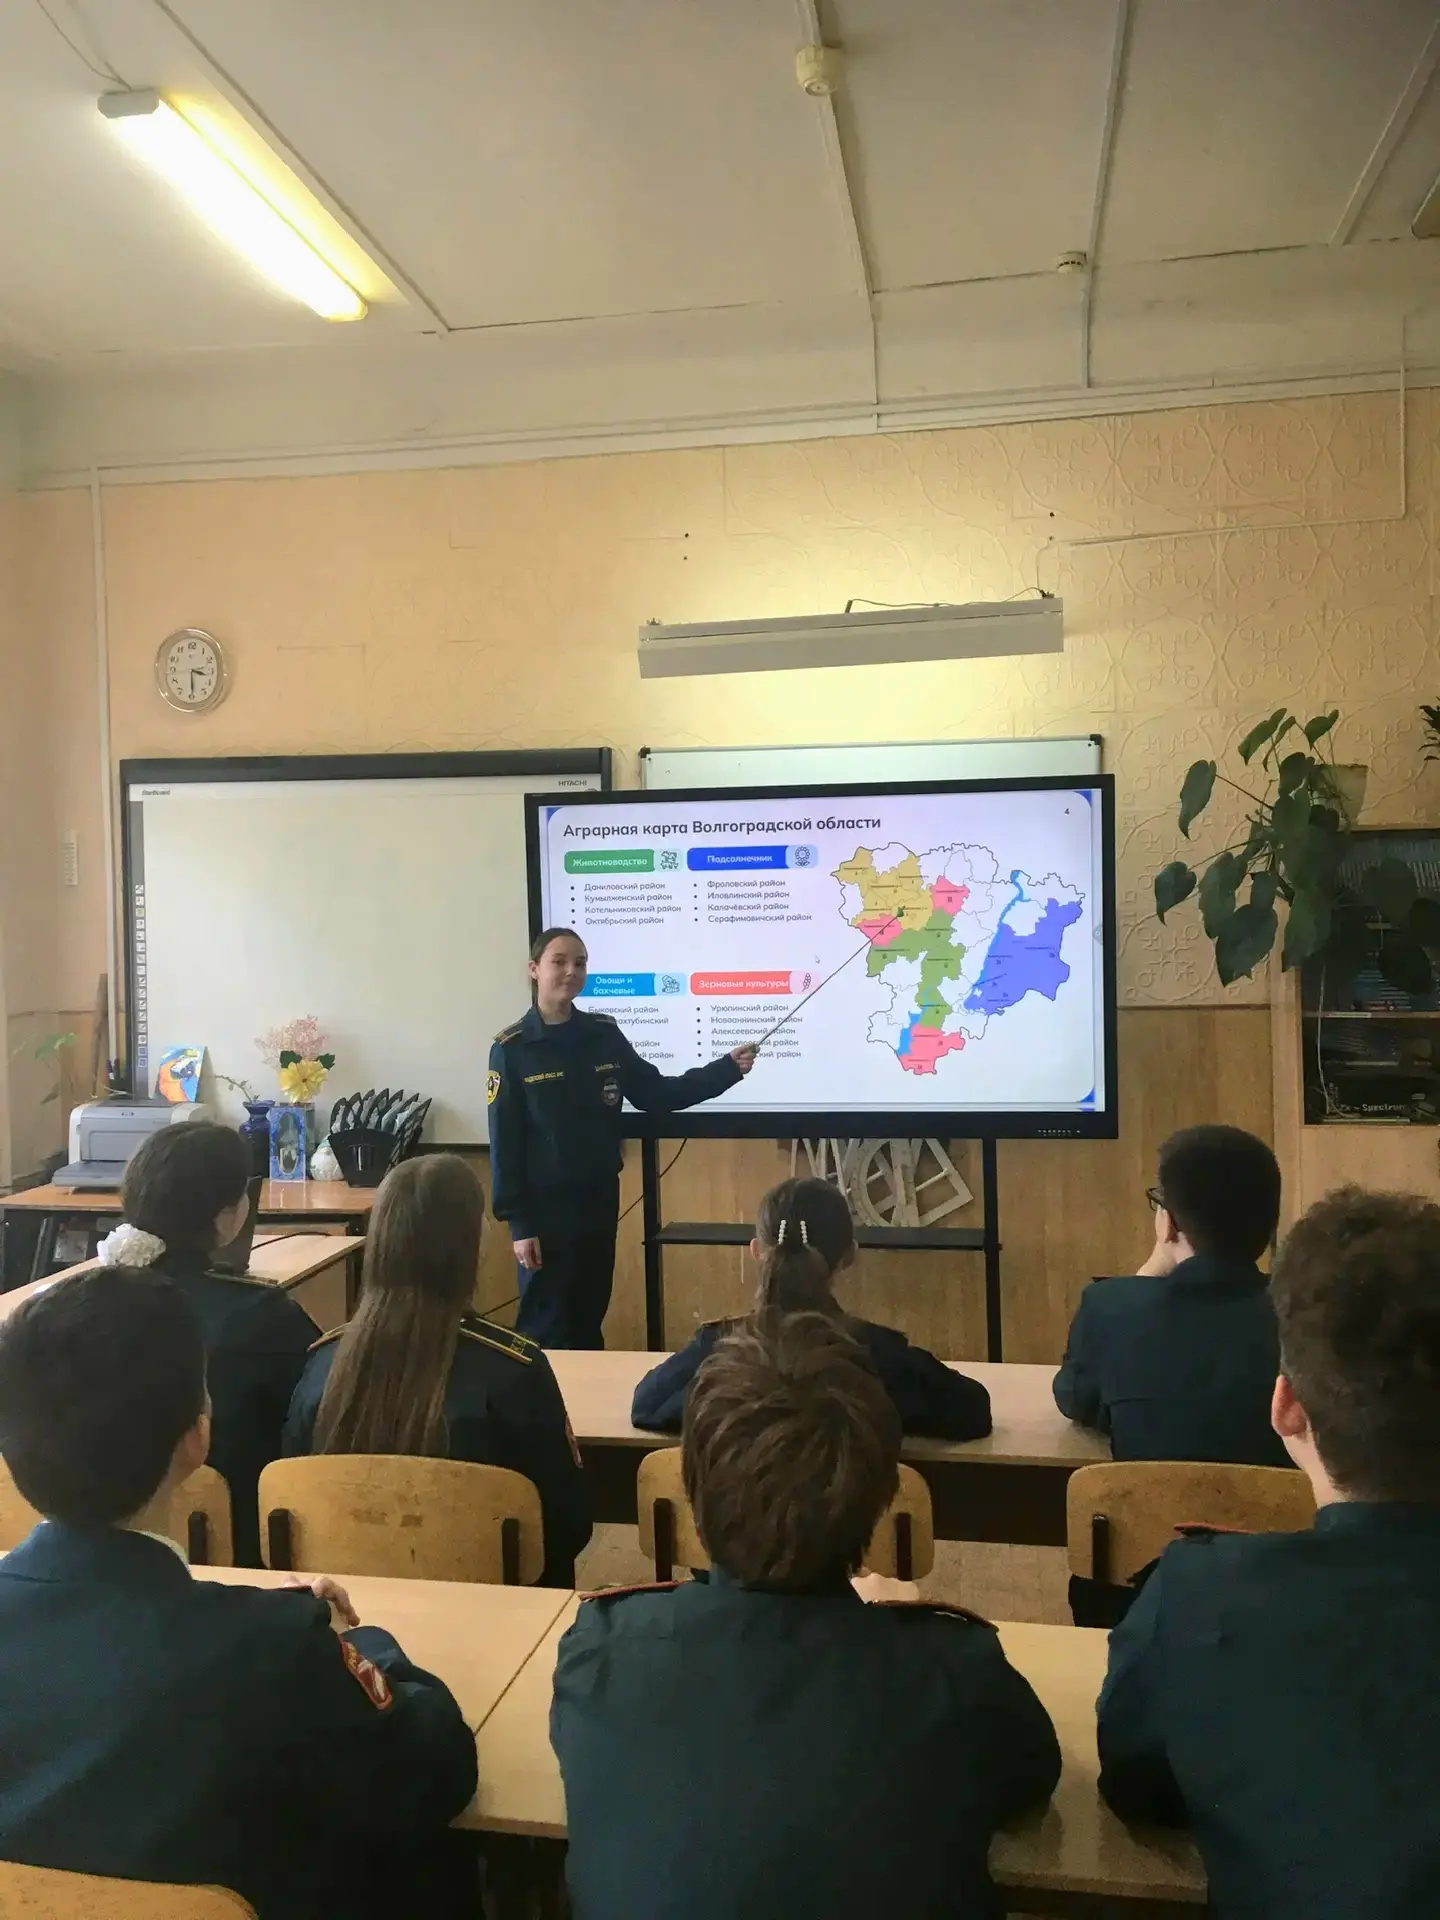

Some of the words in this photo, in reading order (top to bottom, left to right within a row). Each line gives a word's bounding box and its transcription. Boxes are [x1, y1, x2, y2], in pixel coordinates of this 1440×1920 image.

[563, 823, 638, 839] Аграрная
[643, 822, 688, 837] карта
[692, 817, 812, 834] Волгоградской
[816, 816, 881, 830] области
[572, 857, 648, 867] Животноводство
[707, 854, 773, 865] Подсолнечник
[584, 883, 638, 892] Даниловский
[640, 882, 665, 891] район
[707, 879, 758, 888] Фроловский
[760, 879, 786, 888] район
[584, 894, 646, 903] Кумылженский
[647, 893, 672, 902] район
[707, 891, 762, 899] Иловлинский
[764, 890, 790, 900] район
[585, 905, 655, 914] Котельниковский
[656, 904, 682, 913] район
[763, 902, 789, 911] район
[585, 916, 637, 926] Октябрьский
[639, 916, 664, 925] район
[708, 914, 784, 924] Серафимовичский
[786, 913, 812, 923] район
[595, 976, 625, 986] Овощи
[699, 980, 744, 989] Зерновые
[745, 978, 789, 989] культуры
[593, 986, 636, 995] бахчевые
[588, 1006, 632, 1014] Быковский
[633, 1005, 659, 1015] район
[710, 1004, 761, 1014] Урюпинский
[763, 1004, 789, 1012] район
[618, 1016, 669, 1026] ахтубинский
[710, 1015, 776, 1024] Новоаннинский
[711, 1027, 768, 1035] Алексеевский
[634, 1039, 660, 1048] район
[773, 1038, 799, 1048] район
[648, 1051, 674, 1060] район
[775, 1050, 801, 1059] район
